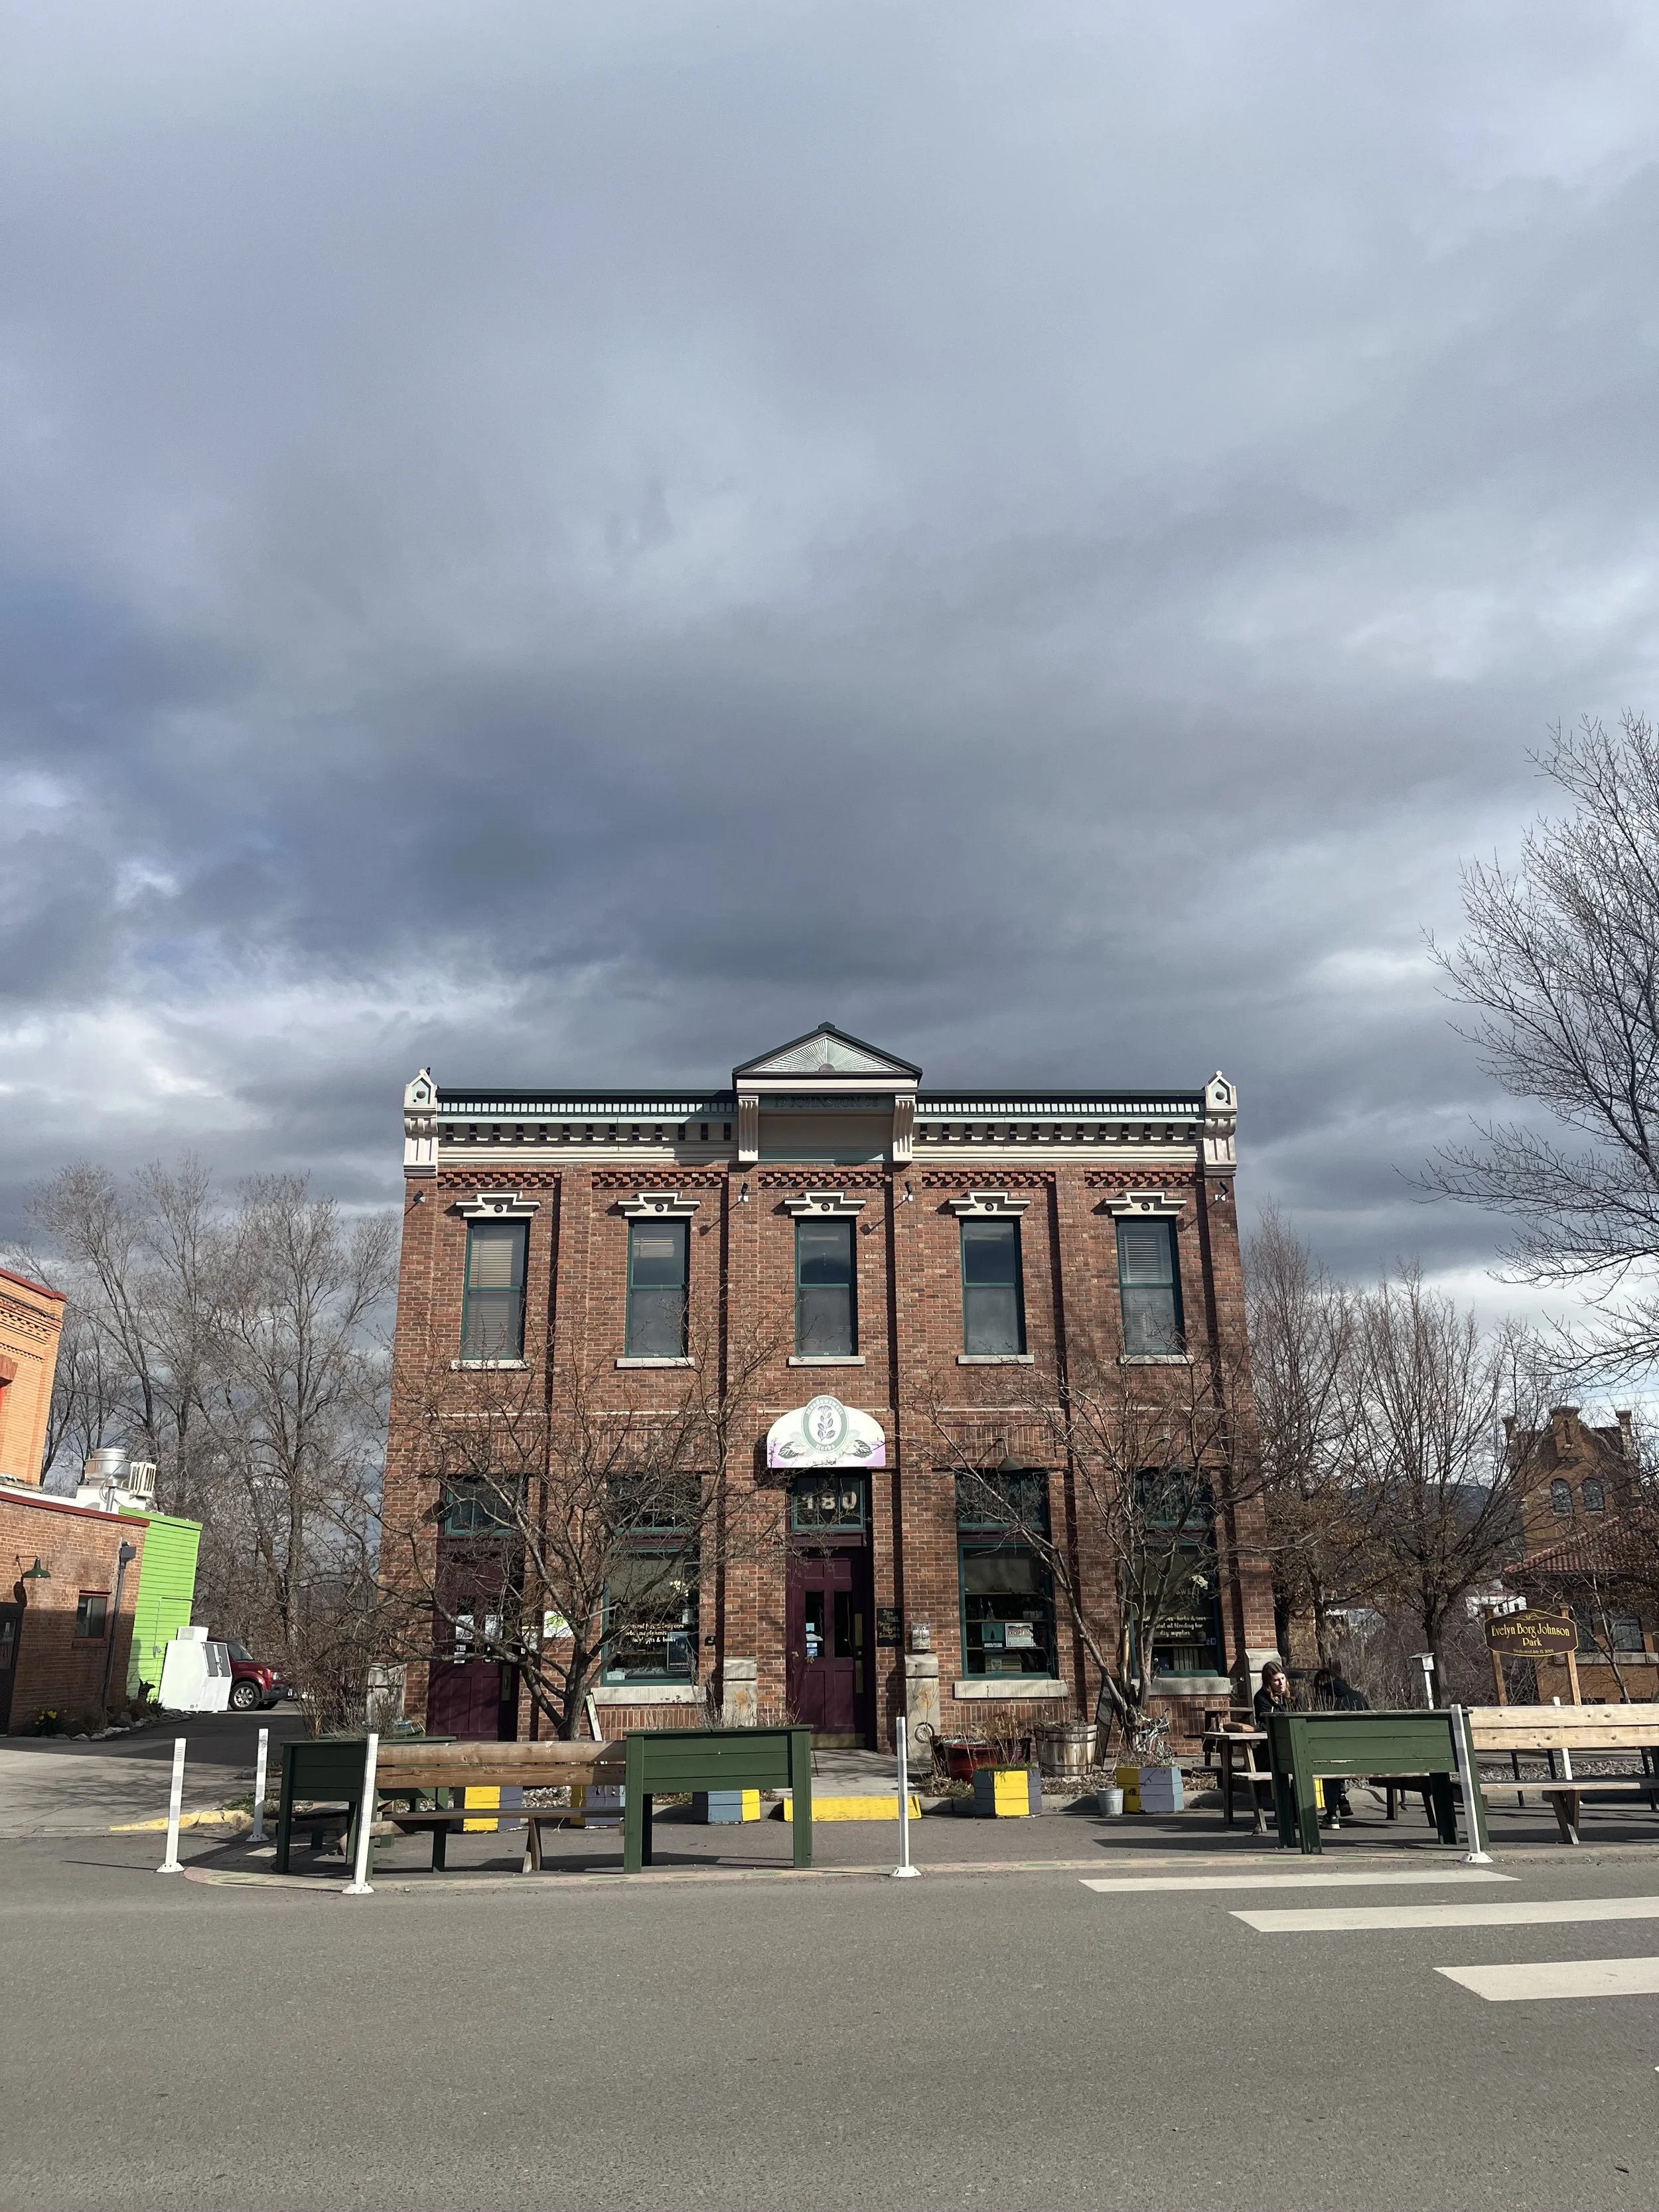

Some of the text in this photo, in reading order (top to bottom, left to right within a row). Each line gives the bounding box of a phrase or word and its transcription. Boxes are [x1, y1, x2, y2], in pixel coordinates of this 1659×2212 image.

[774, 1096, 786, 1108] 19
[789, 1096, 861, 1108] JOHNSTON
[806, 1399, 844, 1416] Meadowsweet
[802, 1492, 857, 1510] 180
[1490, 1623, 1570, 1639] Evelyn Borg Johnson
[1522, 1637, 1542, 1646] Park
